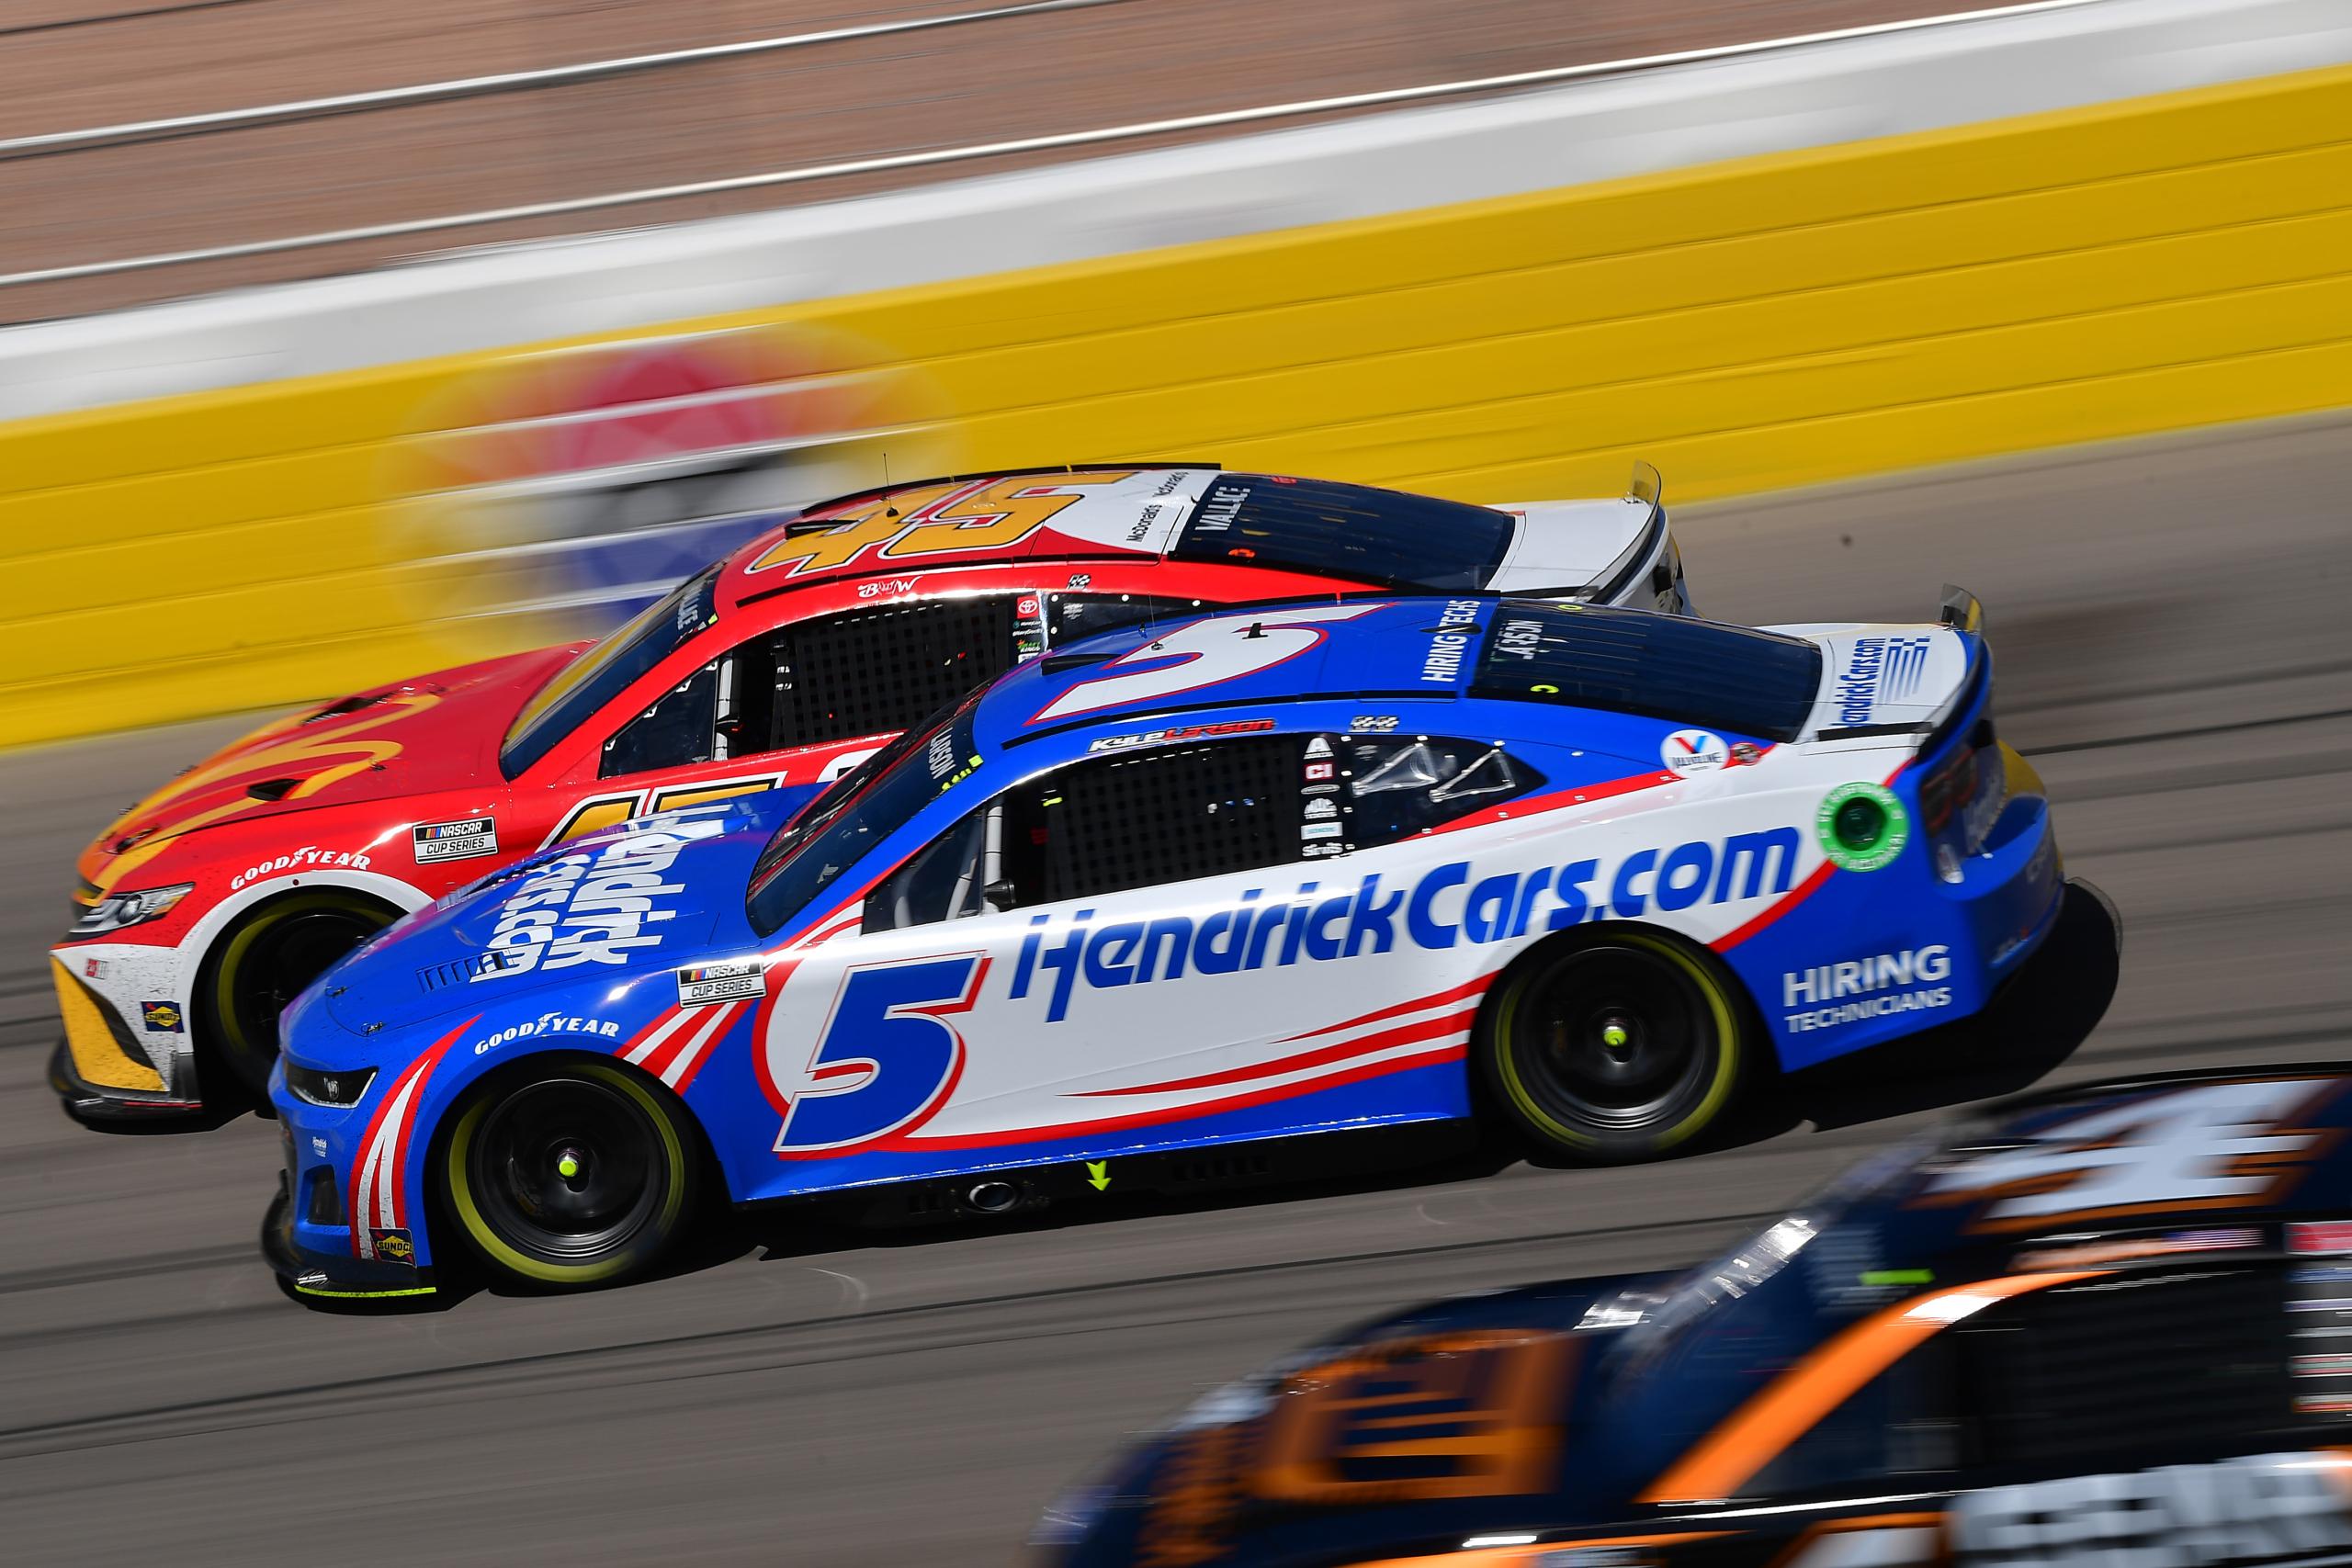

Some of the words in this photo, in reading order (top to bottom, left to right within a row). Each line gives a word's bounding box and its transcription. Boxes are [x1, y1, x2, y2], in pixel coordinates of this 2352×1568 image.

[744, 471, 1139, 580] 45
[1420, 635, 1469, 682] HIRING
[1498, 619, 1545, 660] ARSON
[1022, 601, 1395, 727] 5
[928, 726, 956, 781] LARSON
[426, 840, 447, 854] CUP
[448, 837, 485, 852] SERIES
[440, 821, 483, 839] NASCAR
[1009, 826, 1803, 1024] HendrickCars.com
[691, 982, 714, 998] CUP
[714, 979, 752, 995] SERIES
[705, 963, 751, 979] NASCAR
[1782, 944, 1951, 1007] HIRING
[1783, 987, 1952, 1033] TECHNICIANS
[774, 950, 993, 1159] 5
